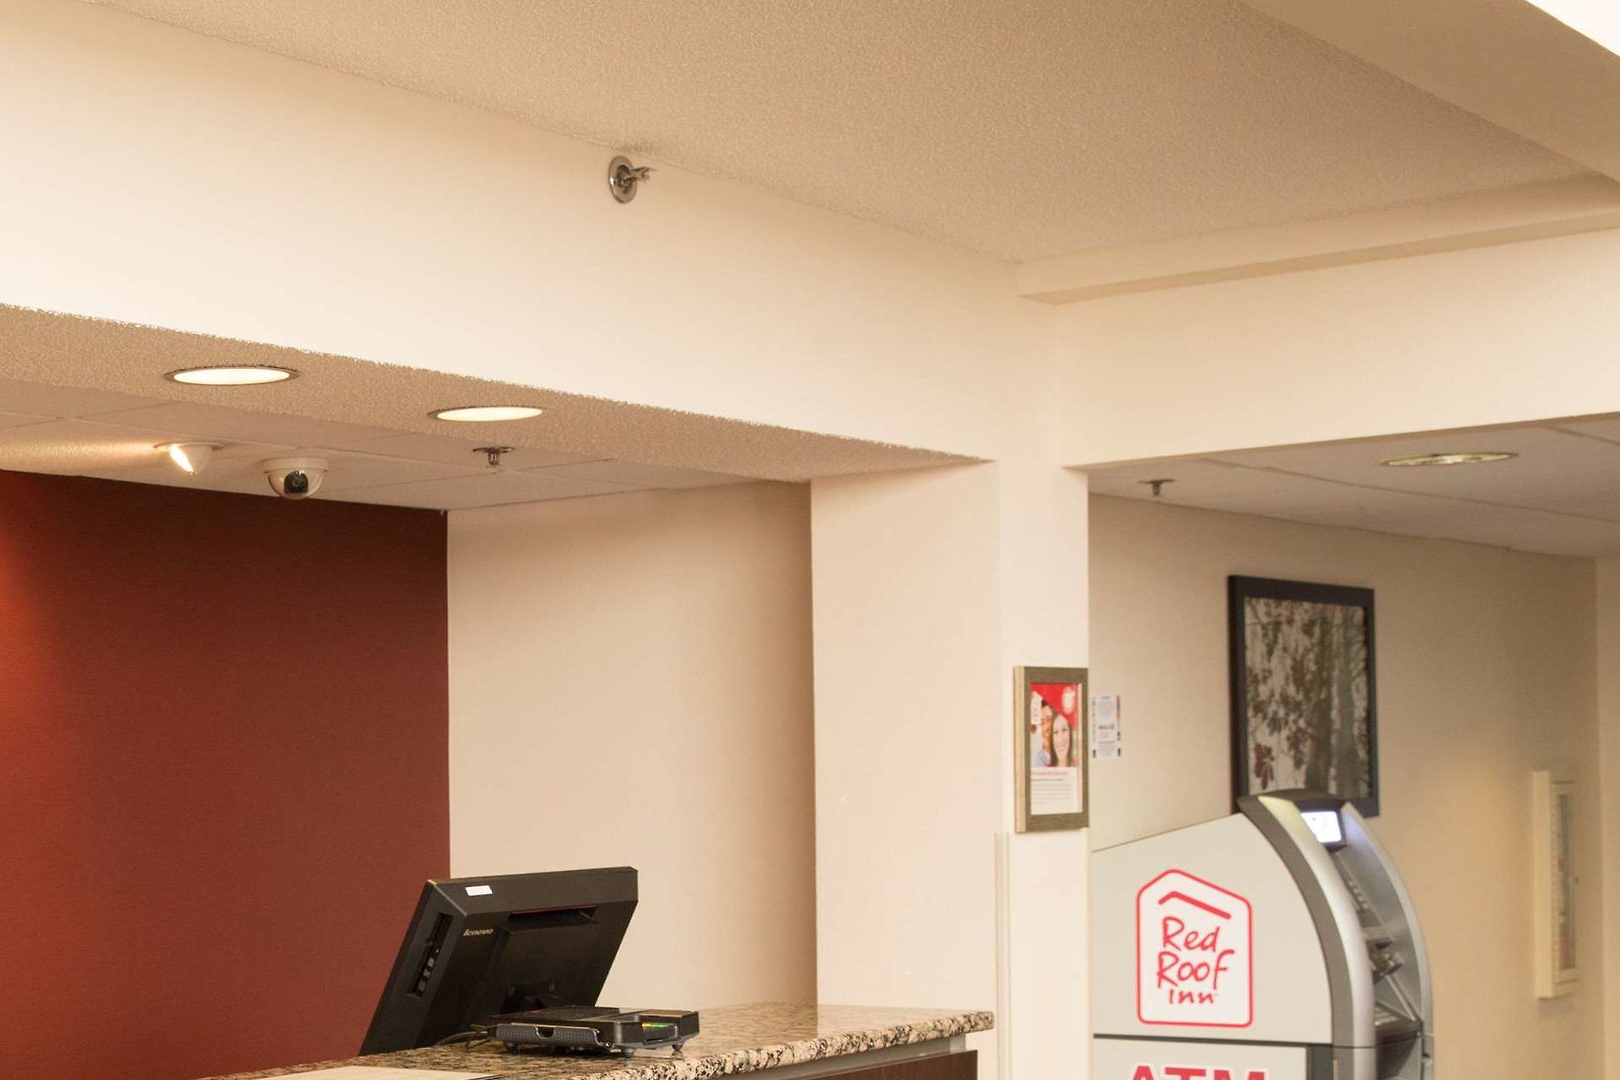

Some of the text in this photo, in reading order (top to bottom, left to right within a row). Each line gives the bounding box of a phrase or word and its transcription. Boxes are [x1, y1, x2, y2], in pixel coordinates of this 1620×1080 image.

[463, 928, 494, 937] lenovo
[1162, 916, 1219, 952] Red
[1156, 949, 1235, 991] Roof
